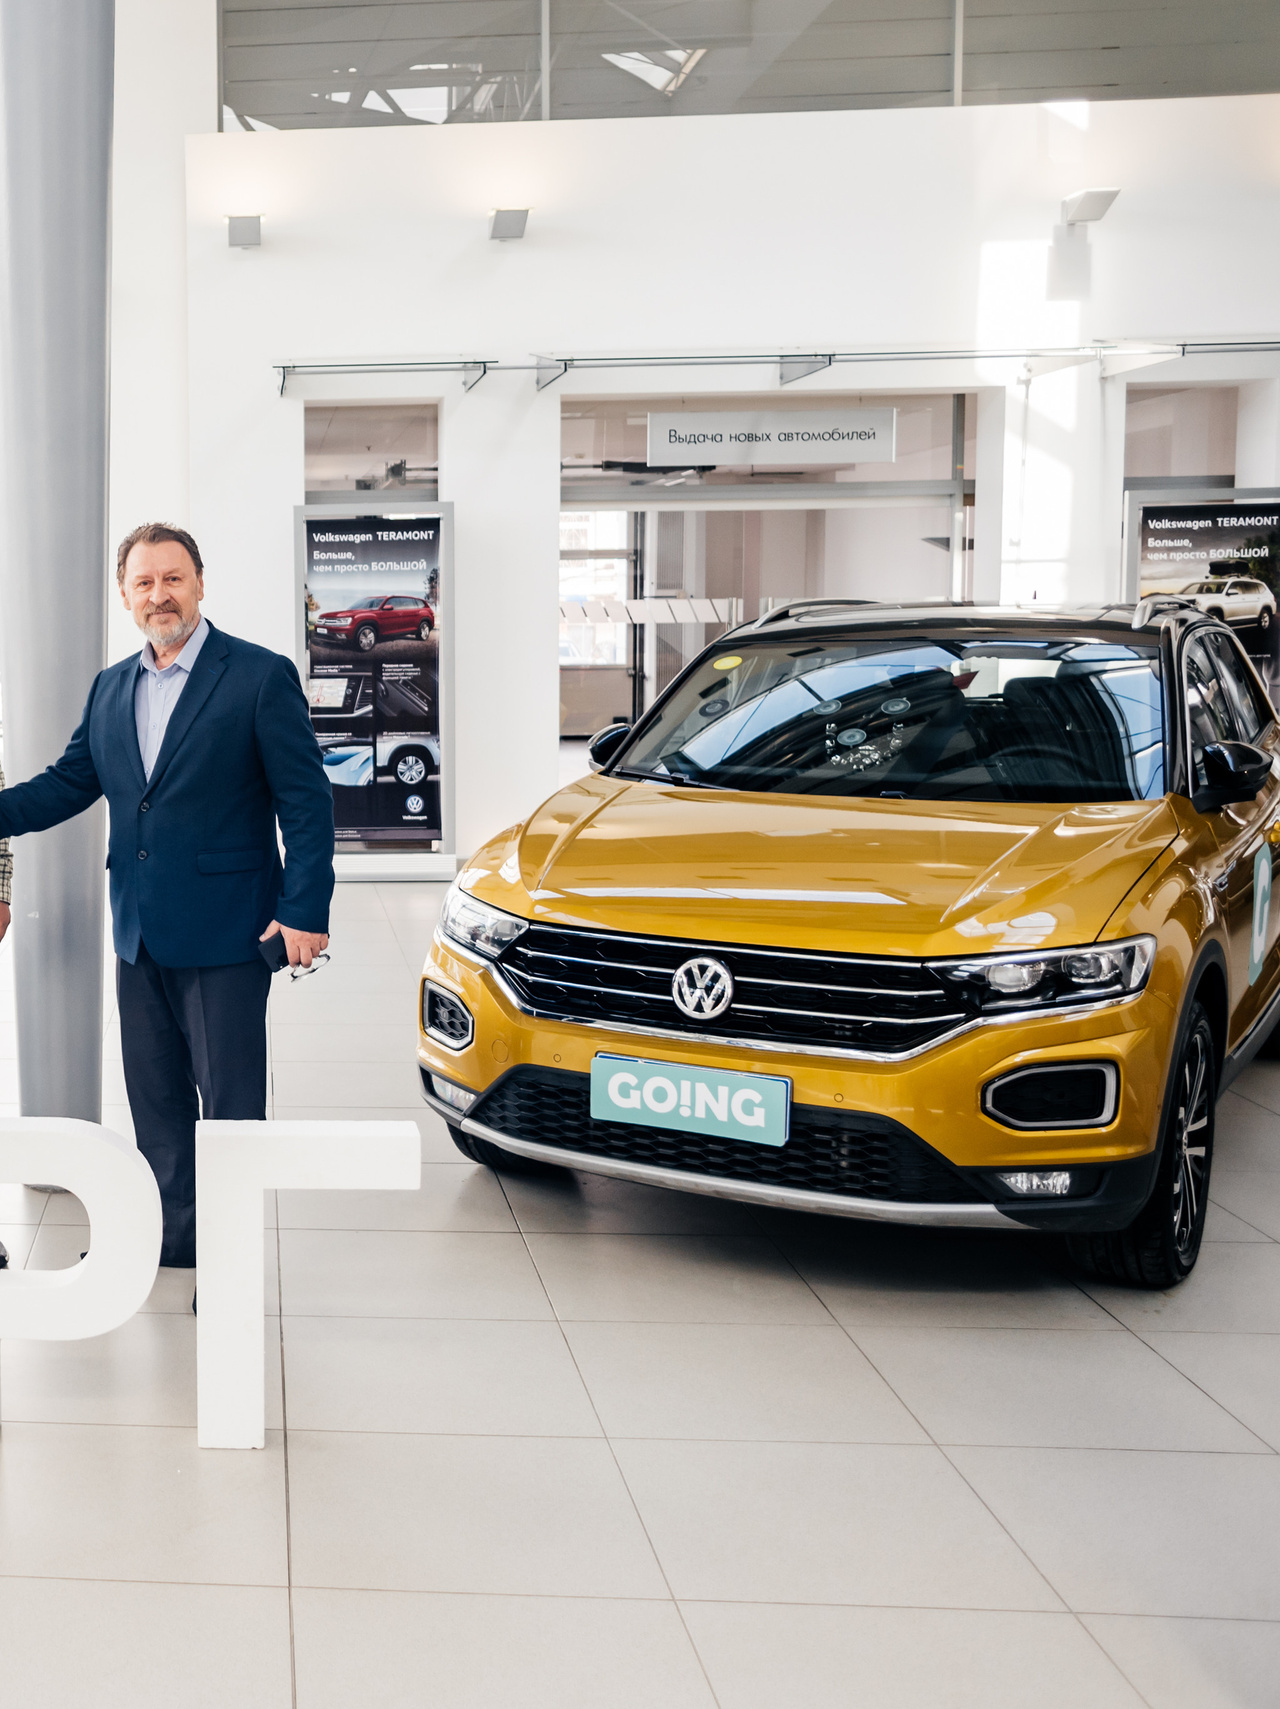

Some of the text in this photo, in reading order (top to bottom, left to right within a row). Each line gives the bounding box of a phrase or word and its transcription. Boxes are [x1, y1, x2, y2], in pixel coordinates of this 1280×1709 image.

[668, 428, 876, 444] Выдача новых автомобилей
[1148, 516, 1279, 530] Volkswagen TERAMONT
[313, 530, 434, 543] Volkswagen TERAMONT
[1147, 538, 1192, 548] Больше,
[313, 551, 355, 560] Больше,
[1147, 546, 1269, 562] чем просто БОЛЬШОЙ
[313, 559, 427, 573] чем просто БОЛЬШОЙ
